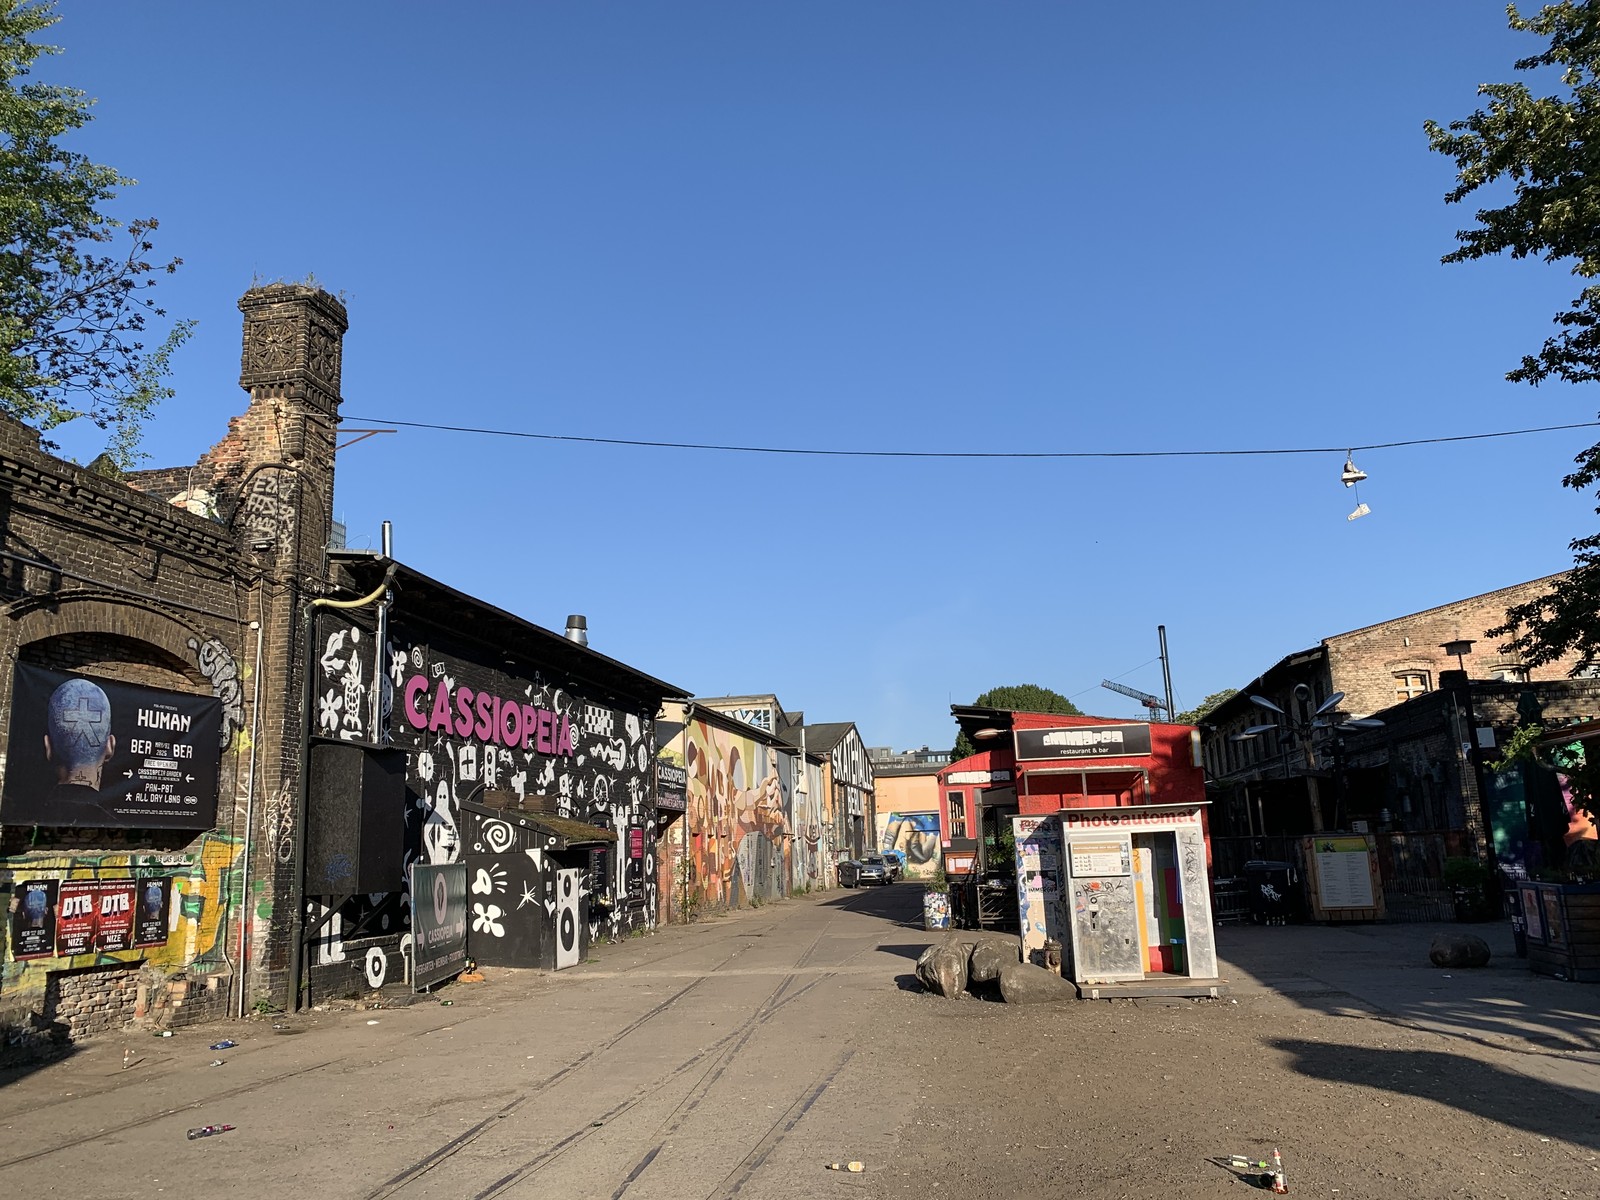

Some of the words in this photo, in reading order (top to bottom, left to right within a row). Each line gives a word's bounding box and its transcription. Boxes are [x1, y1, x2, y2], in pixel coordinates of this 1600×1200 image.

[138, 708, 191, 732] HUMAN
[405, 674, 573, 756] CASSIOPEIA
[131, 739, 152, 754] BER
[173, 744, 192, 759] BER
[658, 766, 686, 783] CASSIOPEIA
[136, 793, 148, 802] ALL
[150, 794, 163, 803] DAY
[1068, 808, 1196, 829] Photoautomat
[61, 895, 93, 918] DTB
[101, 893, 129, 914] DTB
[68, 938, 84, 947] NIZE
[107, 935, 121, 943] NIZE
[428, 925, 453, 944] CASSIOPEIA
